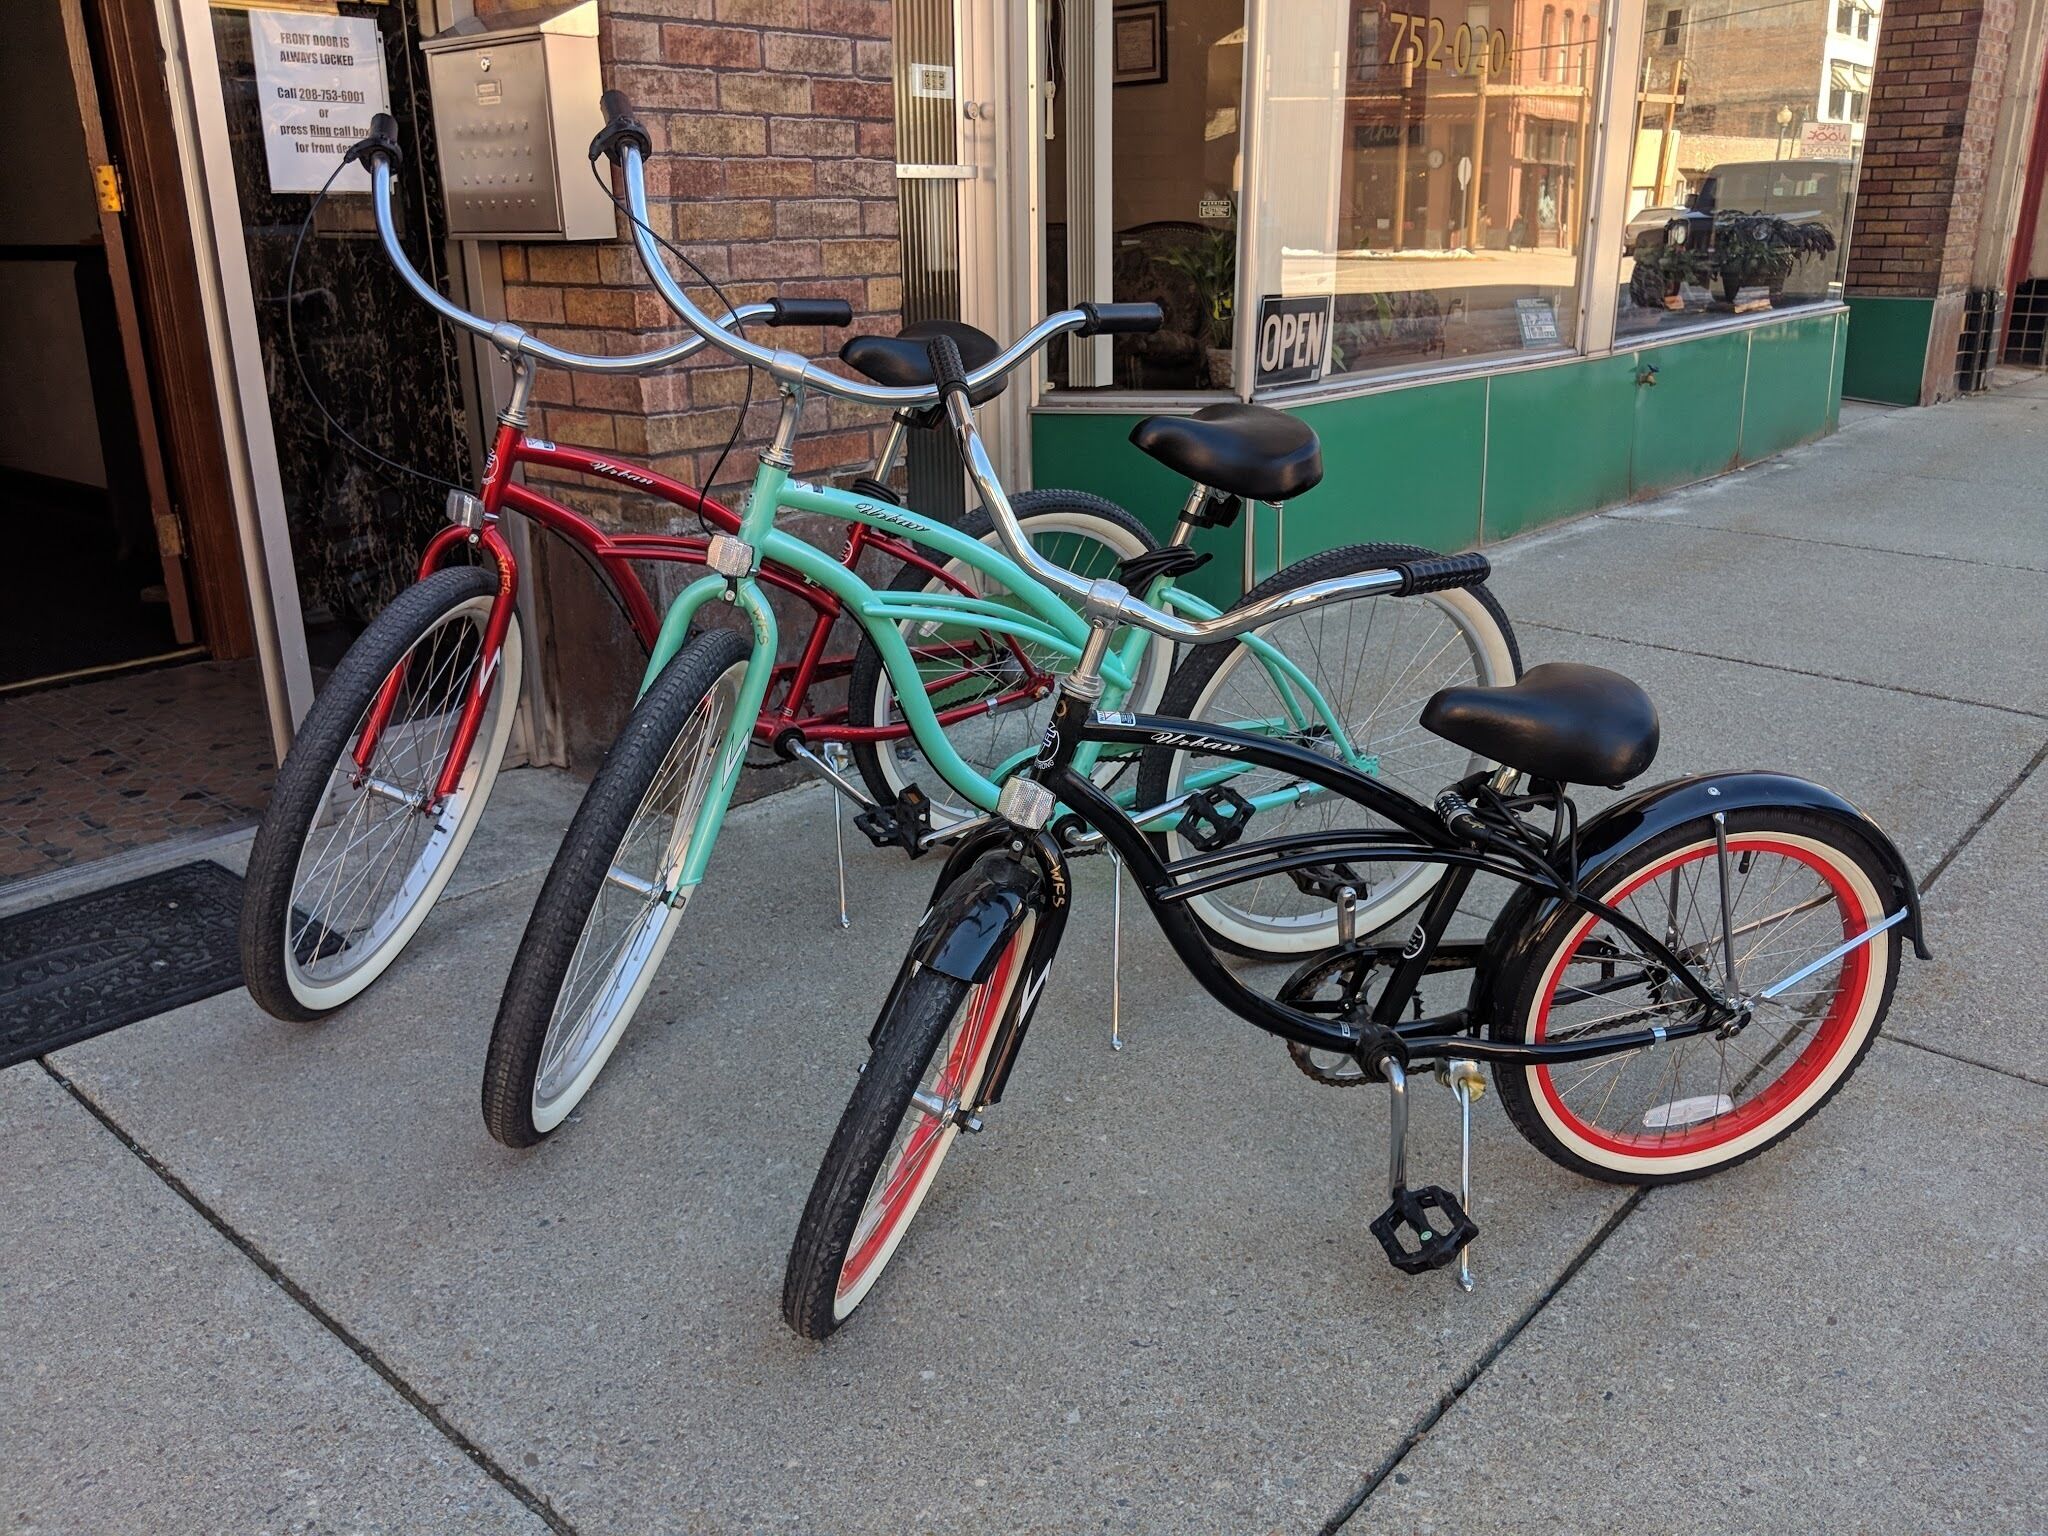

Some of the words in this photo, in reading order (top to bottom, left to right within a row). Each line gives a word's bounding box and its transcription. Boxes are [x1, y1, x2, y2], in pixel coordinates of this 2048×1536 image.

[280, 32, 311, 46] FRONT
[313, 34, 338, 47] DOOR
[340, 37, 350, 49] IS
[279, 51, 318, 65] ALWAYS
[320, 54, 354, 67] LOCKED
[277, 87, 298, 99] Call
[299, 88, 365, 103] 208-753-6001
[319, 108, 329, 118] or
[280, 125, 308, 136] press
[310, 125, 332, 137] Ring
[333, 126, 351, 137] call
[352, 126, 370, 137] box
[295, 142, 309, 153] for
[311, 142, 335, 154] front
[1261, 311, 1325, 372] OPEN
[590, 461, 656, 485] Urban
[855, 503, 931, 532] Urban
[1150, 732, 1248, 752] Urban
[1050, 864, 1066, 908] WFS
